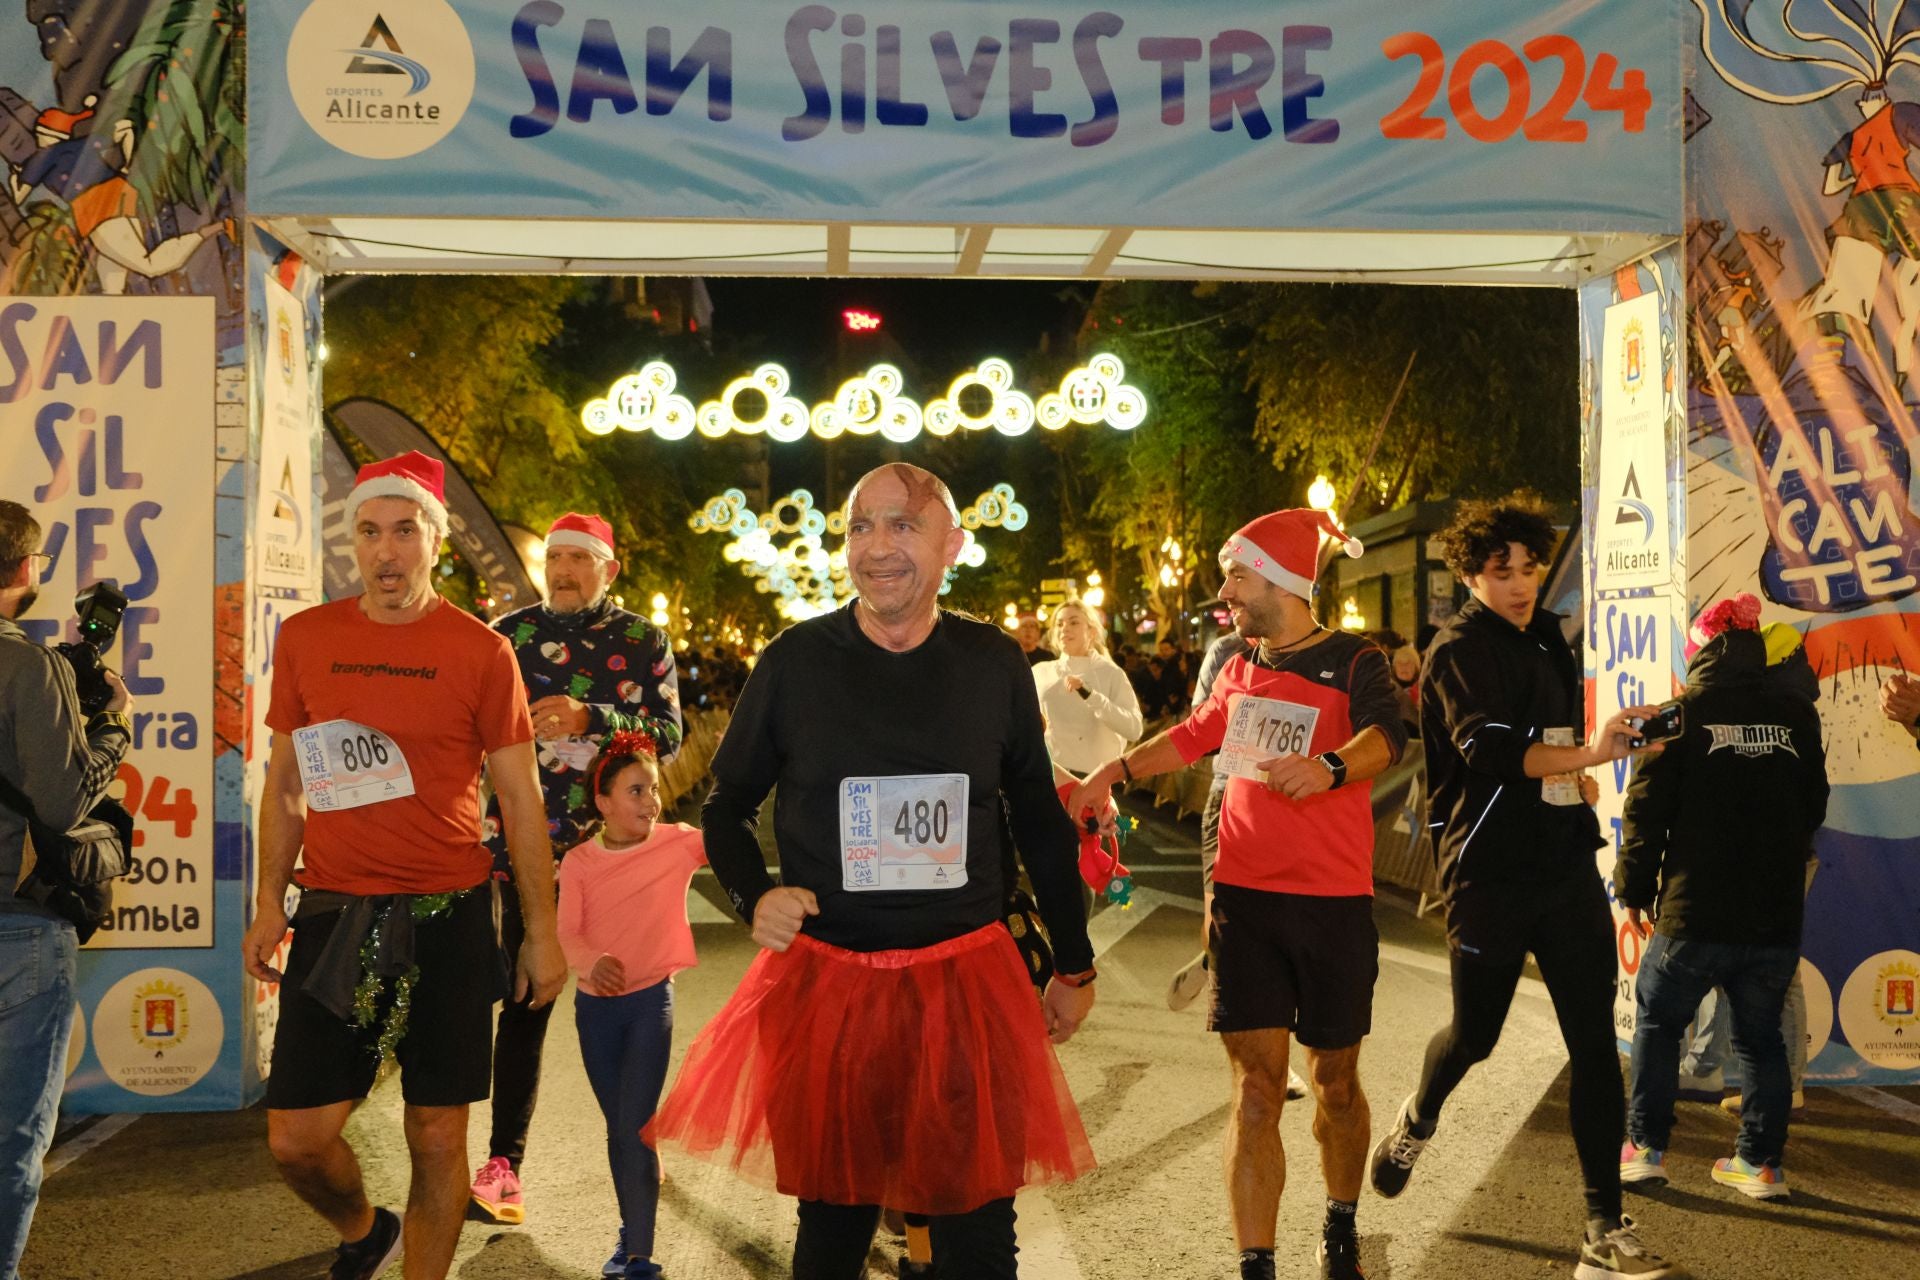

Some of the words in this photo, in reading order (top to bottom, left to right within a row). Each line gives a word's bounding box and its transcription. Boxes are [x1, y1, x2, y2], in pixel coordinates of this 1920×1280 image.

[509, 0, 733, 138] SAN
[1379, 31, 1652, 142] 2024
[326, 87, 384, 97] DEPORTES
[326, 98, 441, 119] Alicante
[0, 302, 162, 404] SAN
[34, 401, 143, 503] SiL
[1768, 424, 1890, 489] ALI
[1777, 490, 1904, 555] CAN
[1606, 549, 1660, 571] Alicante
[1779, 544, 1917, 606] TE
[1605, 604, 1657, 672] SAN
[1255, 716, 1306, 754] 1786
[341, 734, 388, 772] 806
[308, 761, 327, 773] TRE
[309, 780, 333, 792] 2024
[848, 782, 871, 796] SAN
[851, 809, 872, 824] VES
[894, 799, 948, 844] 480
[850, 824, 872, 837] TRE
[847, 847, 878, 861] 2024
[176, 858, 196, 884] h
[99, 903, 200, 933] ambla
[120, 1065, 198, 1075] AYUNTAMIENTO
[125, 1078, 138, 1087] DE
[141, 1077, 192, 1087] ALICANTE
